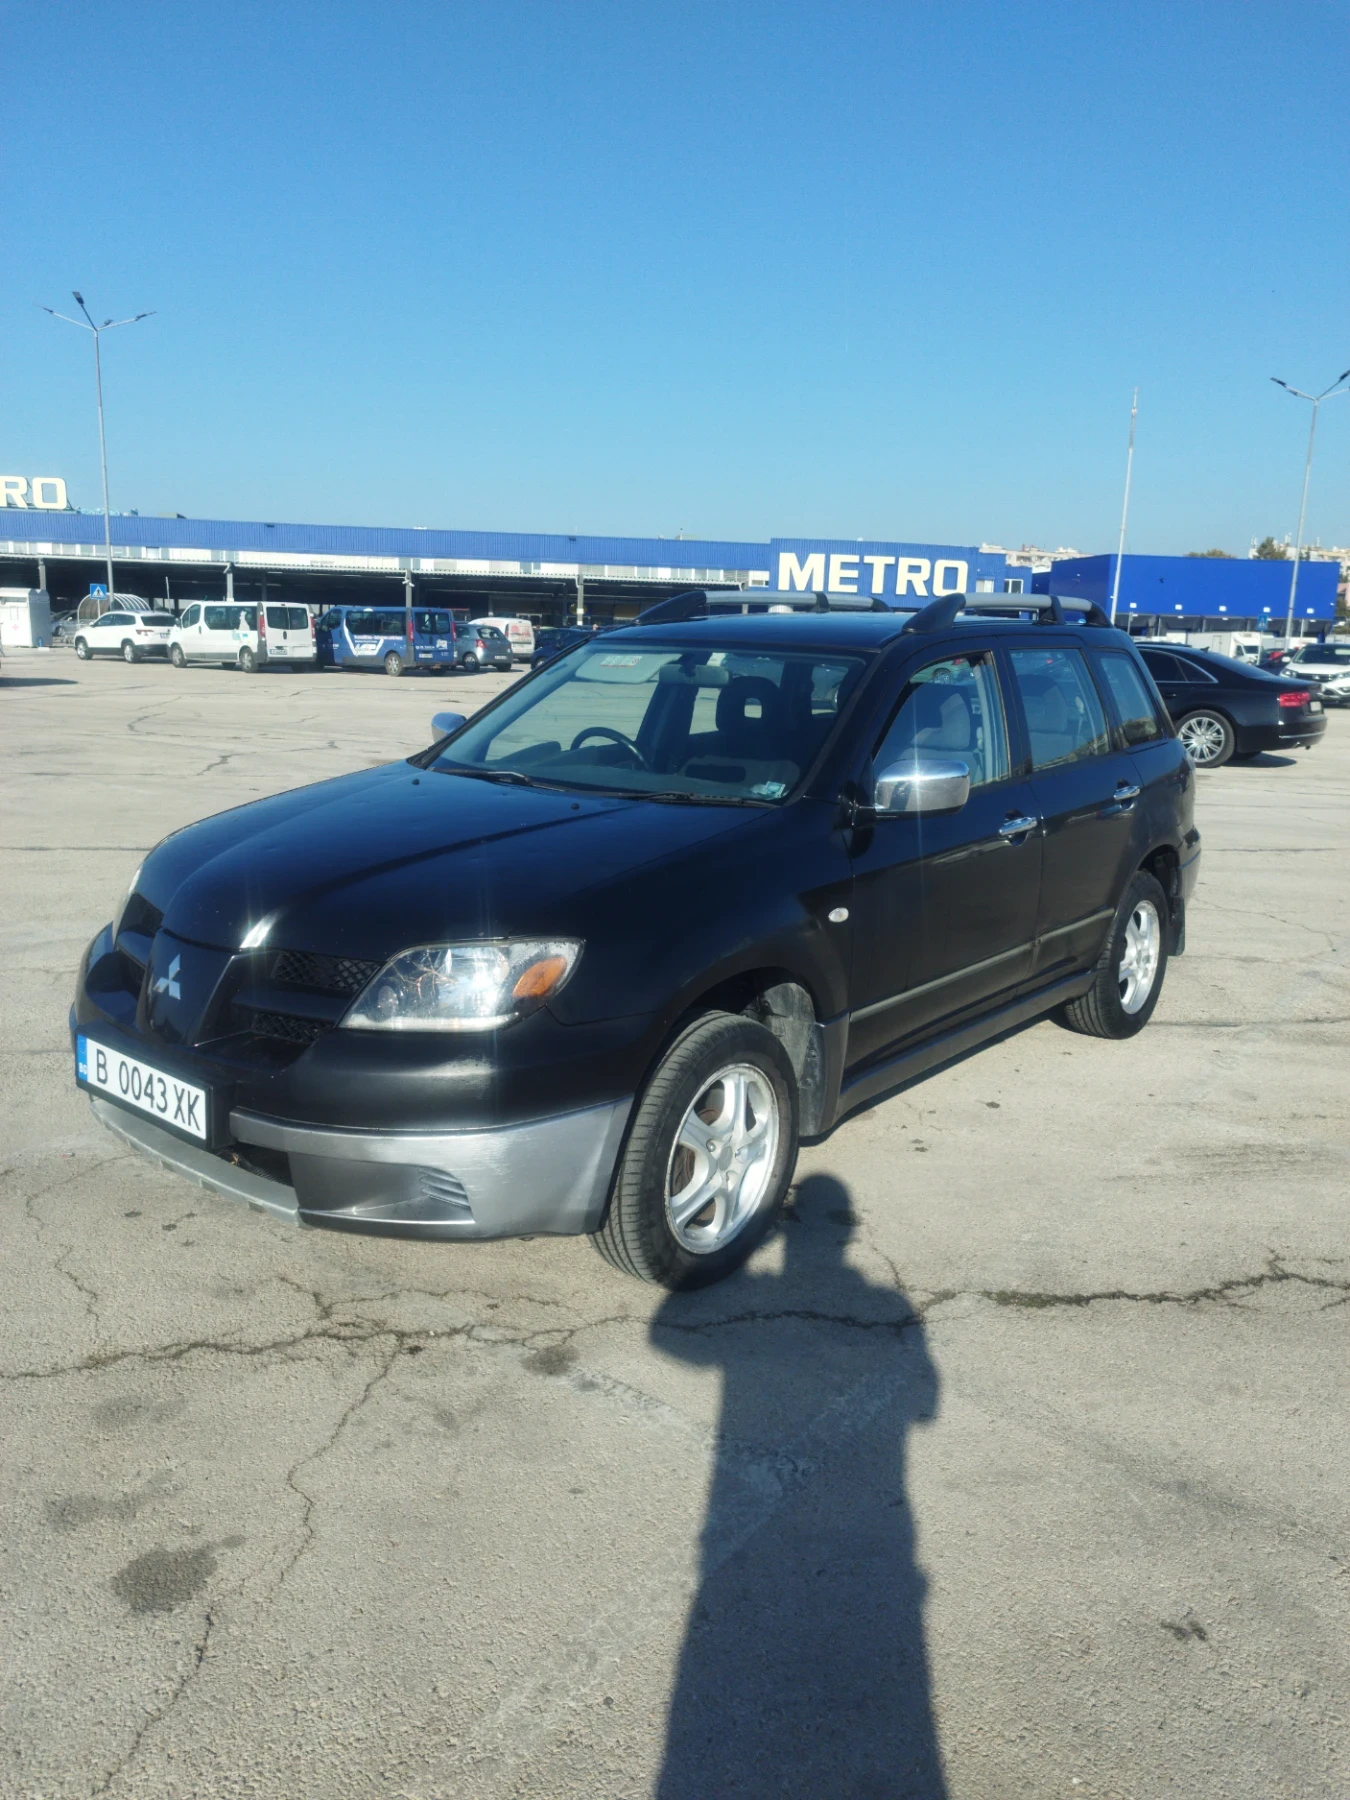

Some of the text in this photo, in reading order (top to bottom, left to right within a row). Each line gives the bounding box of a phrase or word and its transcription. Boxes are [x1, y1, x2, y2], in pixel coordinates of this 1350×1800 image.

[0, 475, 68, 510] RO
[778, 552, 969, 597] METRO
[96, 1048, 201, 1132] B 0043 XK
